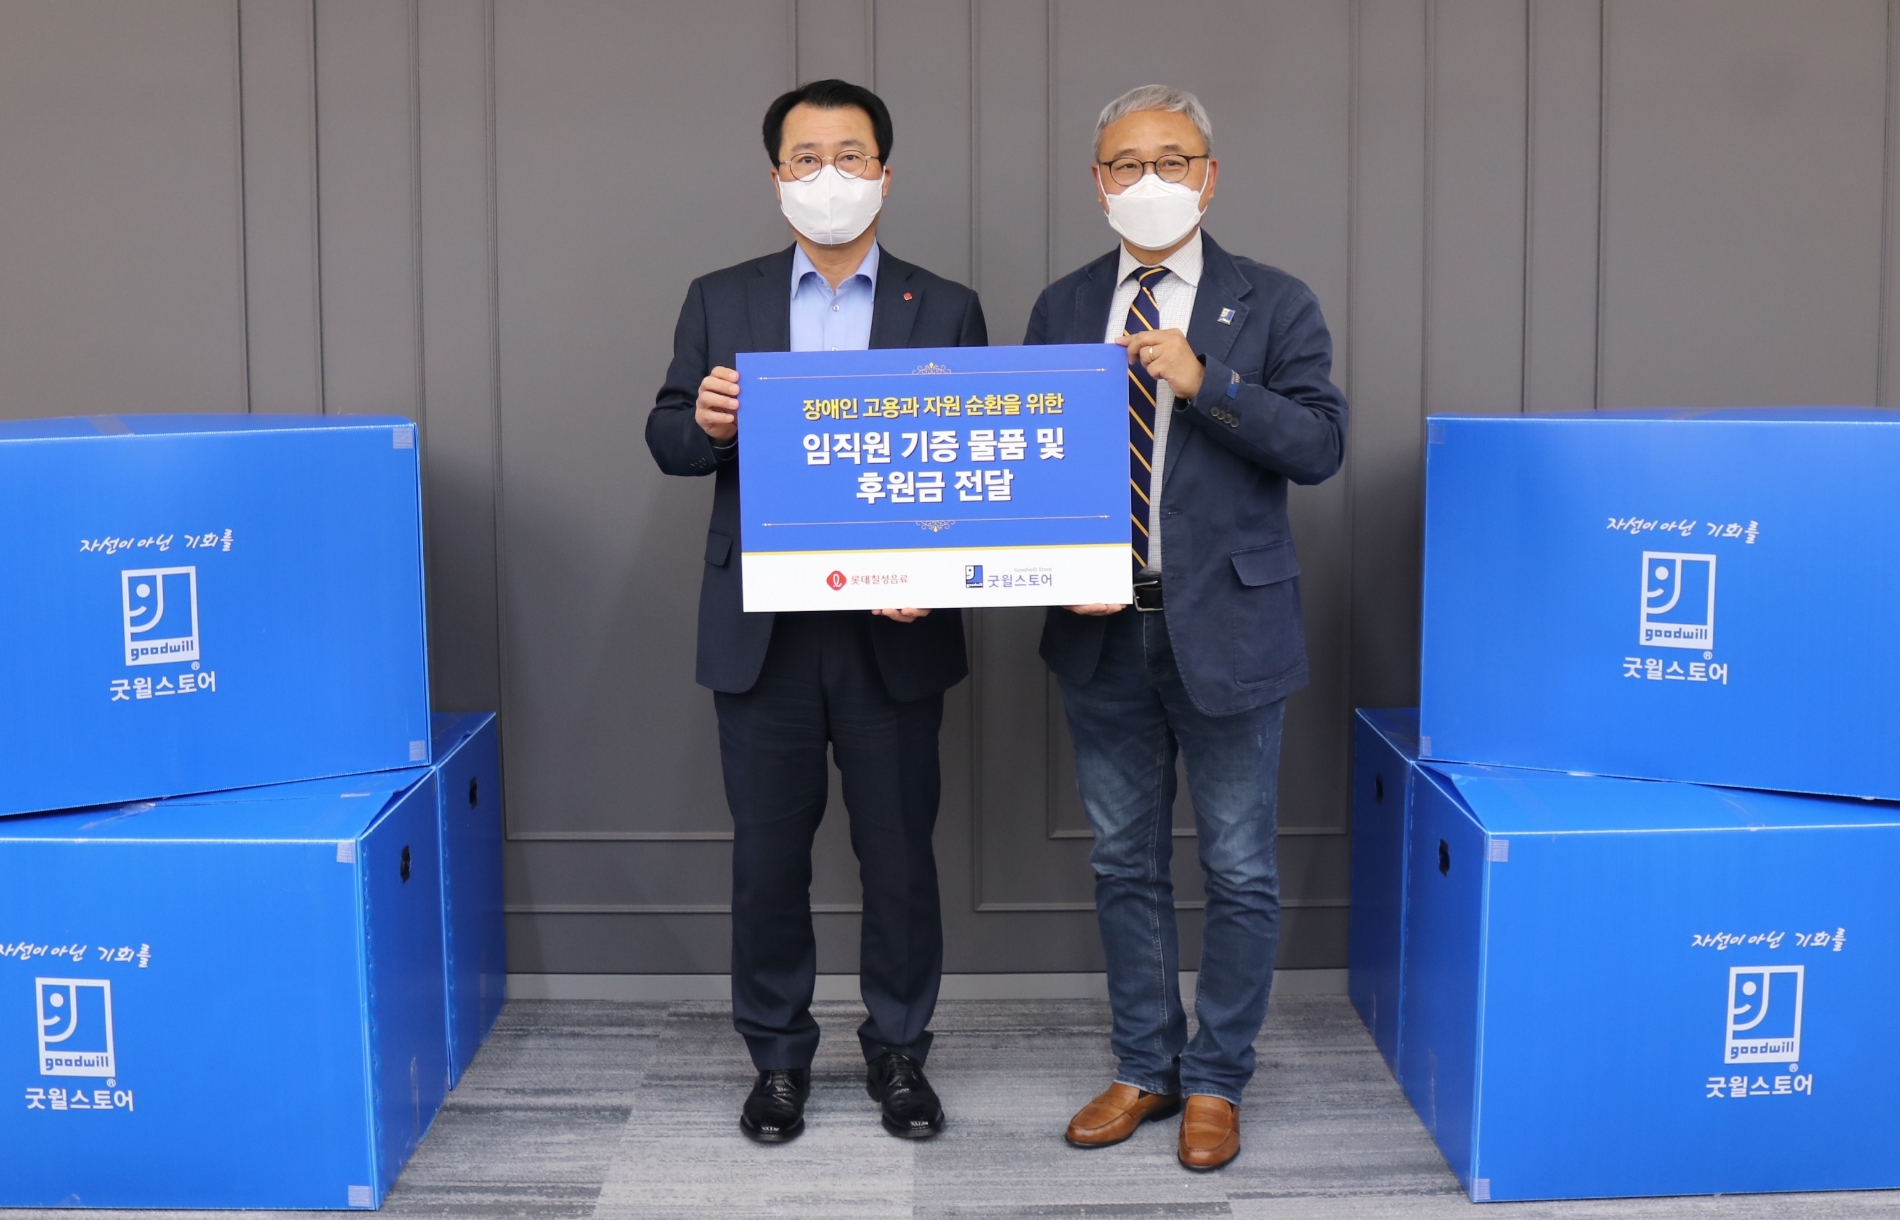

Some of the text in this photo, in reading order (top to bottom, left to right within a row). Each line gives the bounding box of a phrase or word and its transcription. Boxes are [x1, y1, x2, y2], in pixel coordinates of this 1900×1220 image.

[802, 393, 1064, 420] 장애인 고용과 자원 순환을 위한
[803, 427, 1064, 465] 임직원 기증 물품 및
[856, 469, 1013, 504] 후원금 전달
[79, 528, 234, 555] 자선이 아닌 기회를
[1606, 516, 1760, 545] 자선이 아닌 기회를
[851, 574, 909, 585] 롯데칠성음료
[988, 573, 1052, 588] 굿윌스토어
[1645, 627, 1708, 641] goodwill
[130, 640, 194, 661] goodwill
[1622, 656, 1728, 685] 굿윌스토어
[109, 670, 216, 702] 굿윌스토어
[1691, 927, 1847, 952] 자선이 아닌 기회를
[50, 943, 88, 962] 아닌
[97, 943, 152, 968] 기회를
[1730, 1041, 1794, 1059] goodwill
[45, 1055, 109, 1071] goodwill
[1705, 1073, 1813, 1098] 굿윌스토어
[24, 1087, 134, 1112] 굿윌스토어
